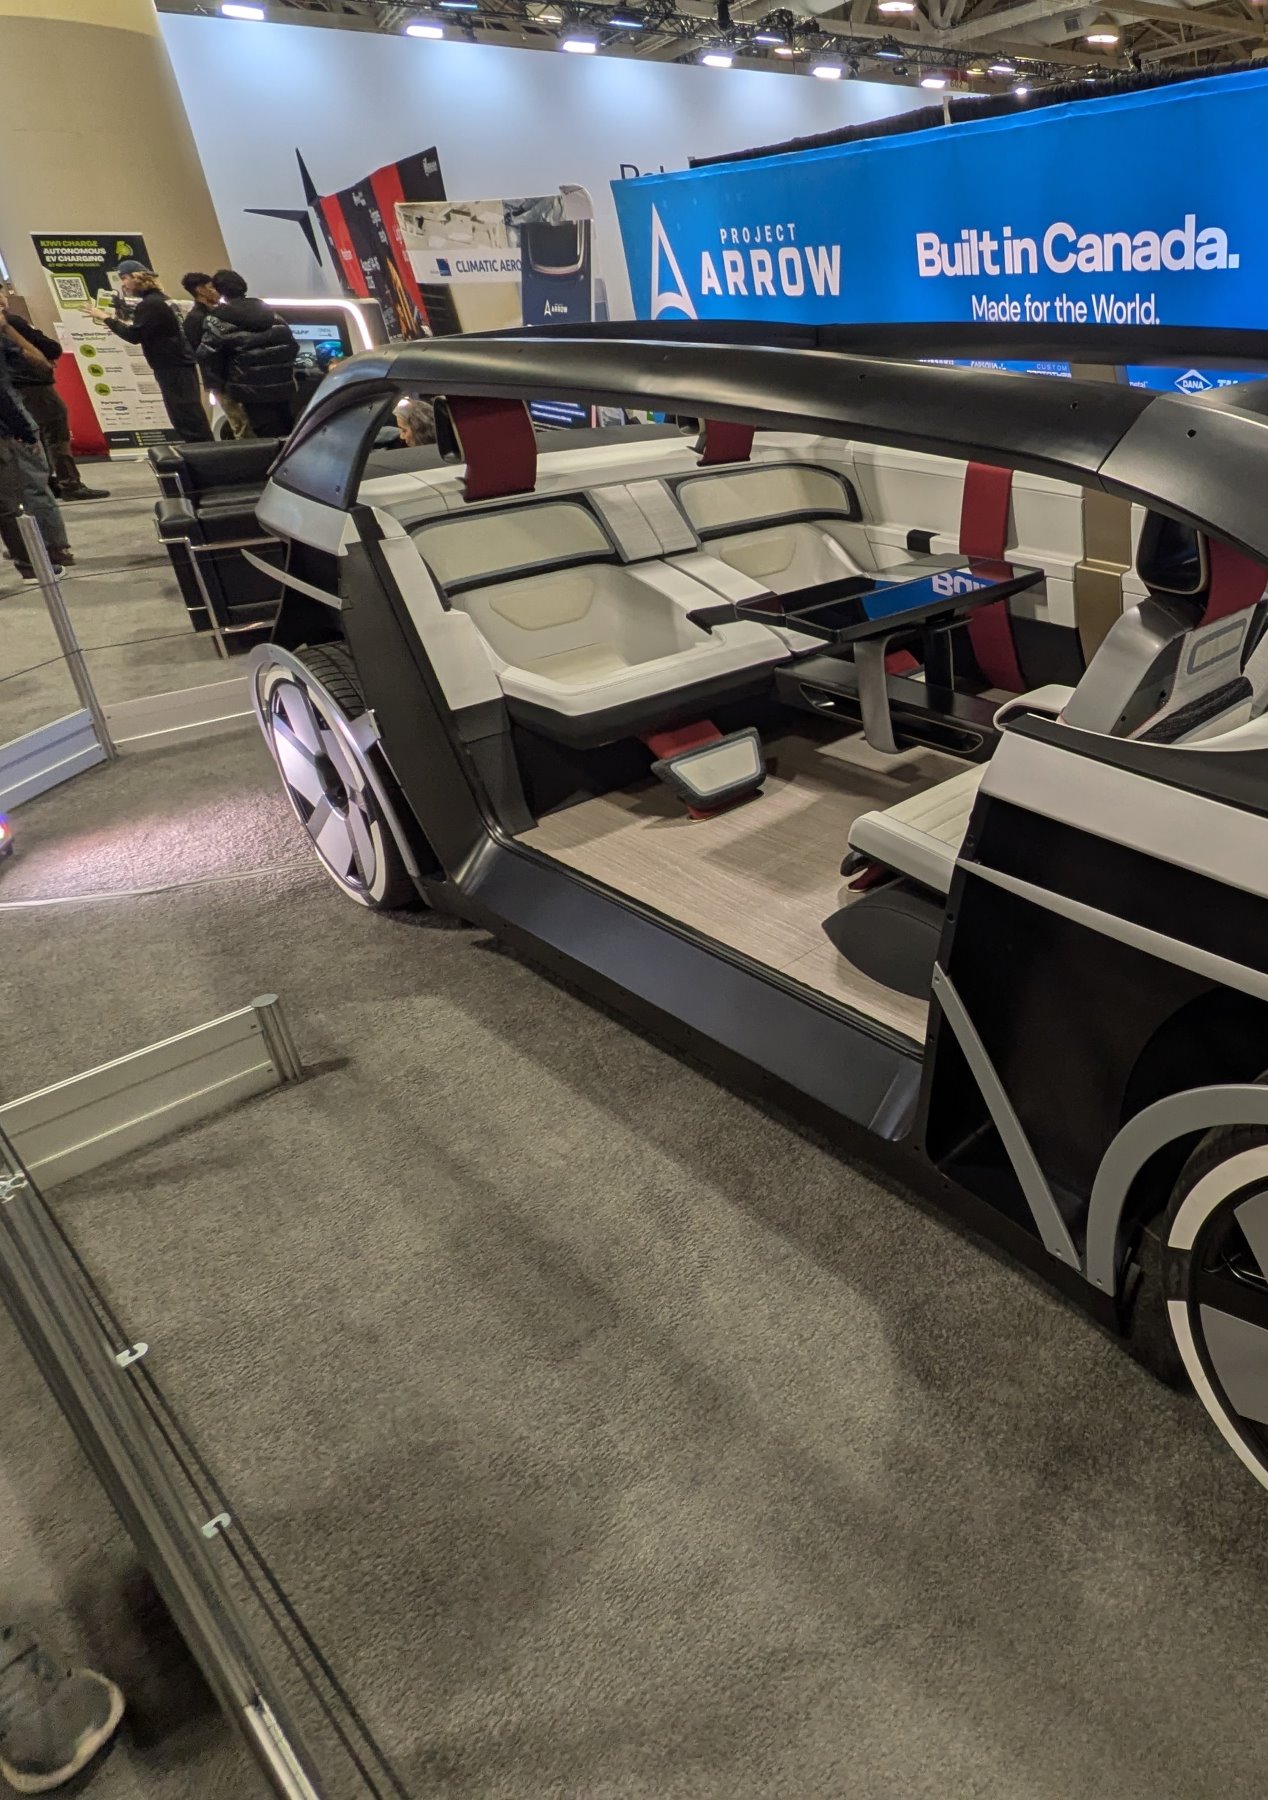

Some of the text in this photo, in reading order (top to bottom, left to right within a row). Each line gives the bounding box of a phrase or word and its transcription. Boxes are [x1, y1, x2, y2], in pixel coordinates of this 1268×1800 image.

[719, 223, 796, 245] PROJECT
[43, 247, 107, 255] AUTONOMOUS
[916, 213, 1240, 277] Built in Canada.
[57, 255, 105, 263] CHARGING
[456, 259, 521, 273] CLIMATIC AERO
[701, 244, 841, 297] ARROW
[971, 293, 1160, 325] Made for the World.
[1182, 380, 1204, 389] DANA
